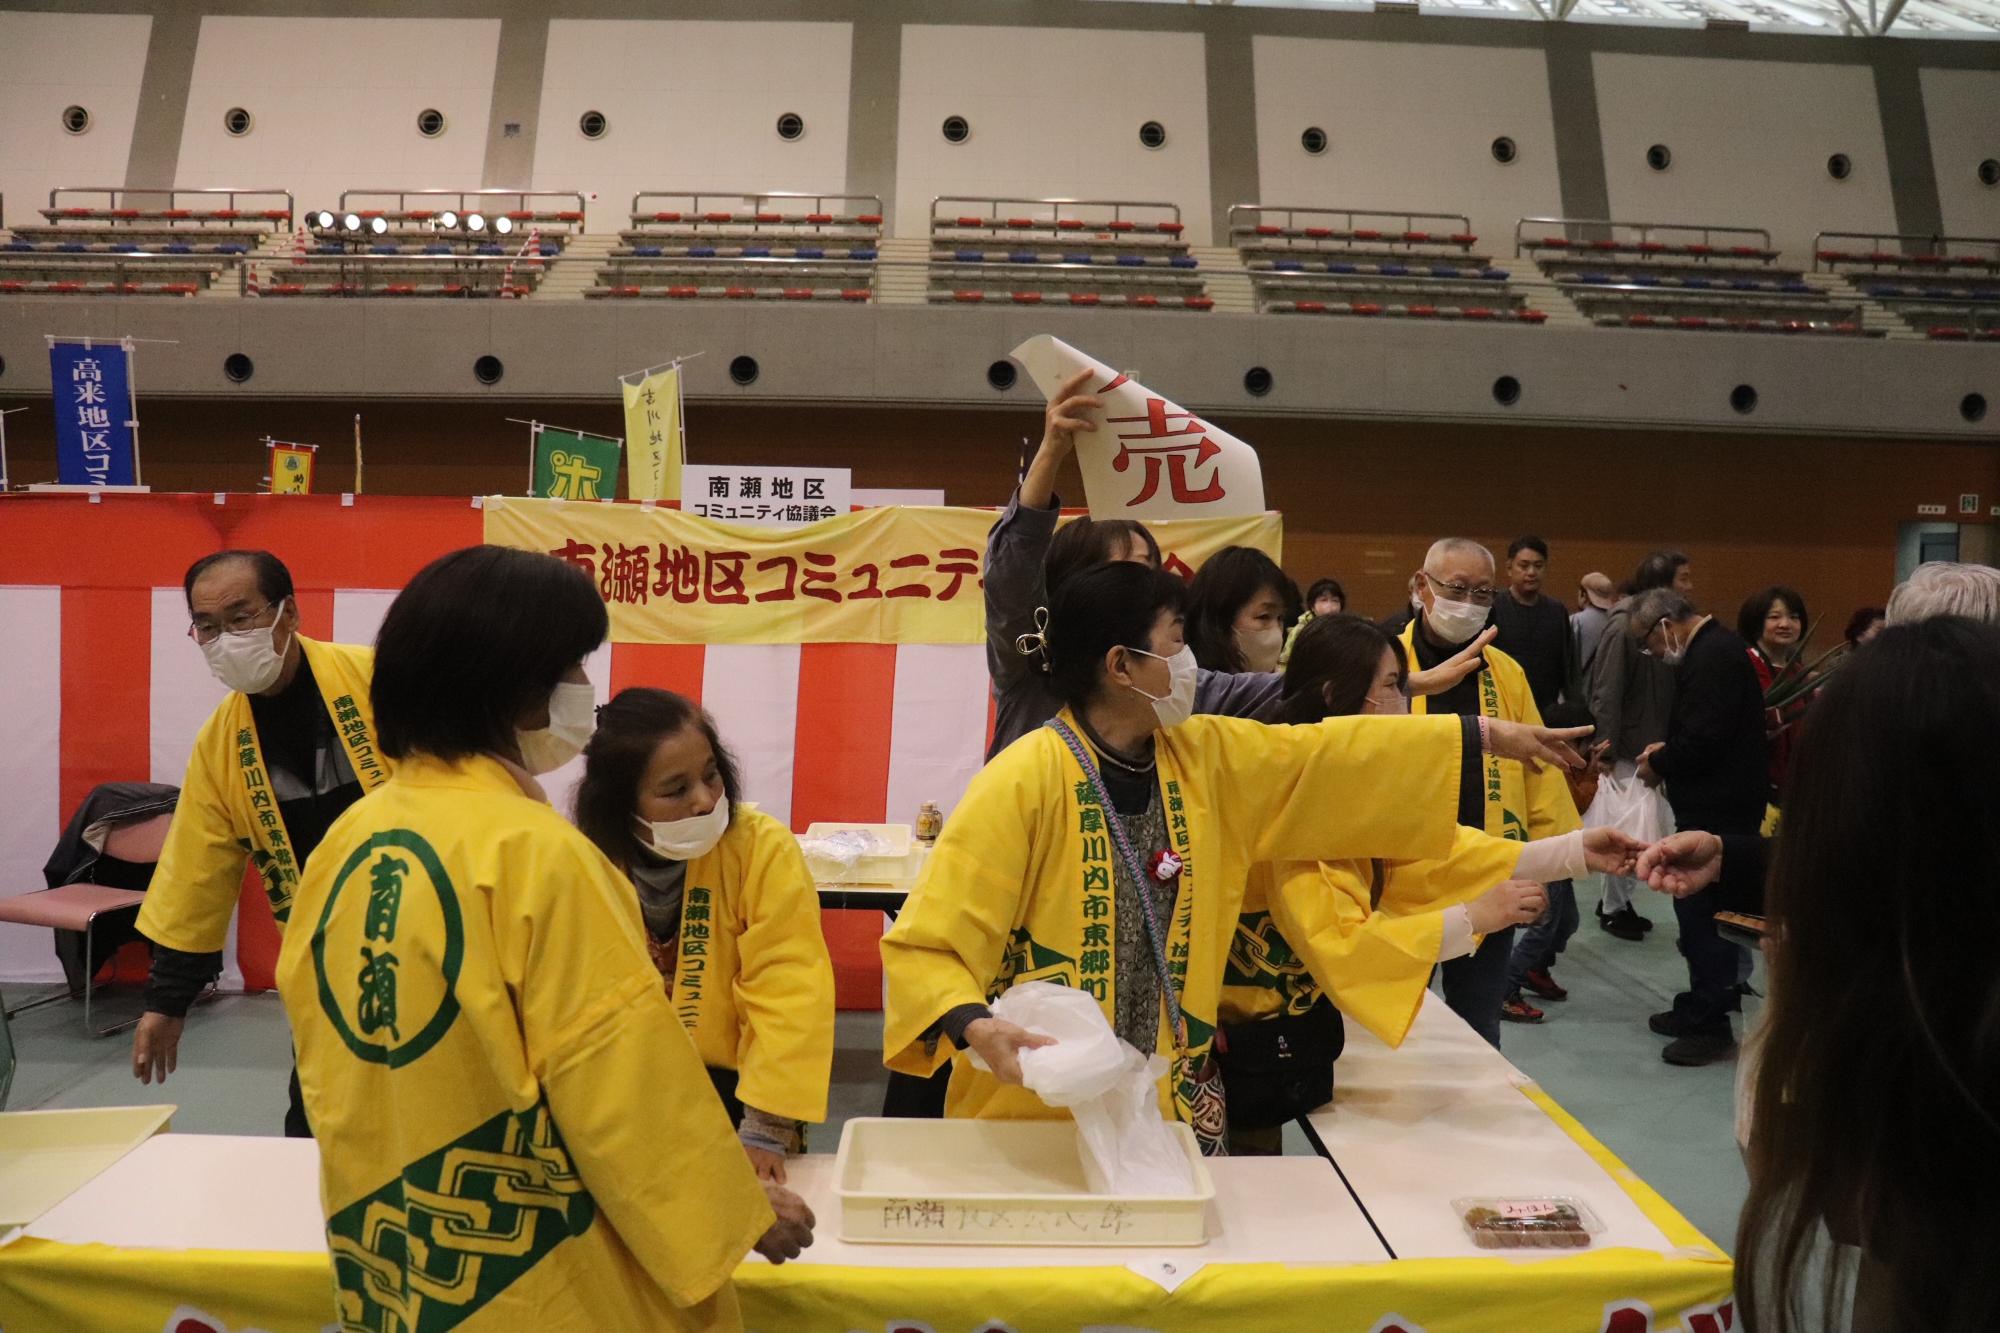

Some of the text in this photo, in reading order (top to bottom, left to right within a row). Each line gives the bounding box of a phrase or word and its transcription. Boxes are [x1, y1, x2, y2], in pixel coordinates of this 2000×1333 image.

[1097, 374, 1225, 506] 売
[549, 450, 601, 499] ポ
[708, 476, 825, 500] 南瀬地区
[694, 504, 837, 522] コミュニティ協議会
[549, 538, 983, 605] 瀬地区コミュニテ
[1075, 781, 1110, 1002] 薩摩川内市東郷町
